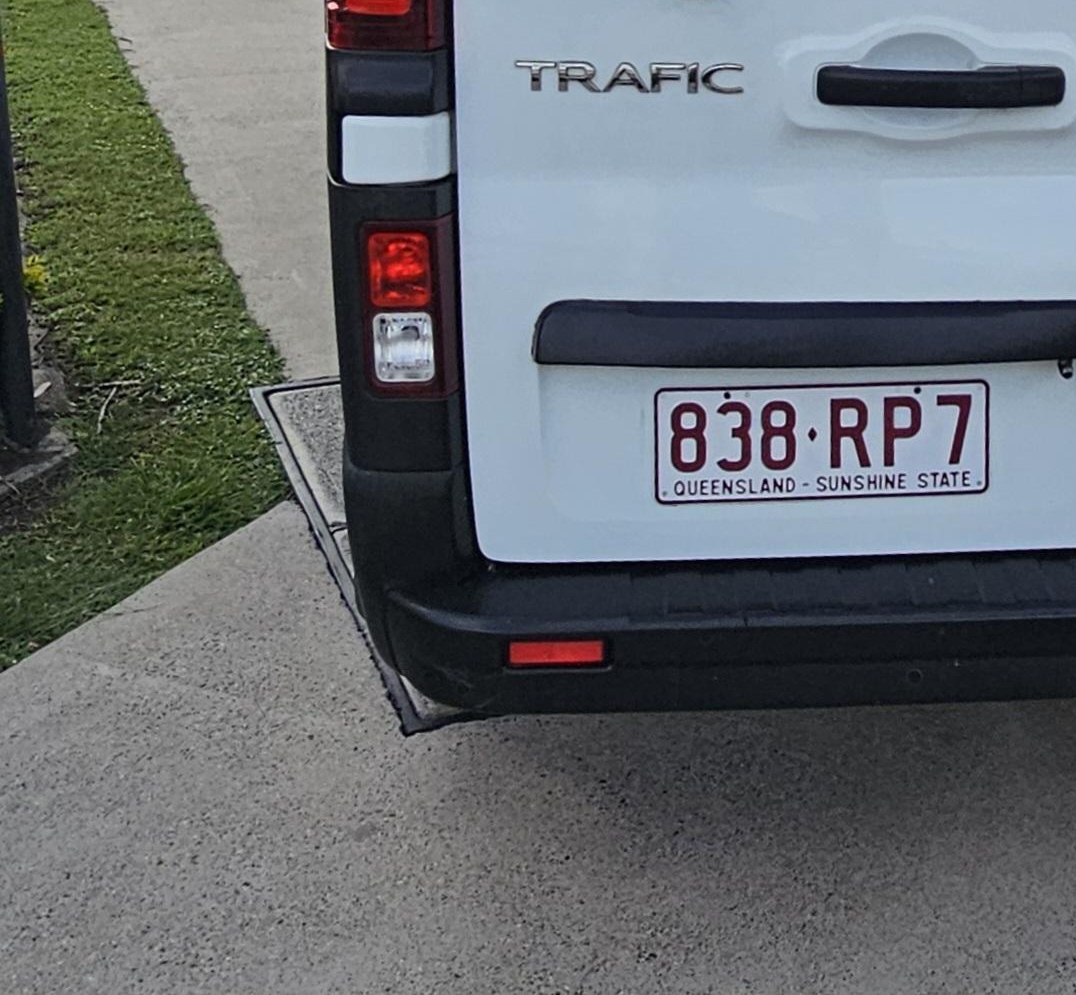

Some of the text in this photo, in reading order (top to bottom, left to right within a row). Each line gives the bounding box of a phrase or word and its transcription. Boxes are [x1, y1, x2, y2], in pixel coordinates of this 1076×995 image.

[514, 60, 744, 94] TRAFIC
[674, 477, 796, 496] QUEENSLAND
[816, 473, 907, 492] SUNSHINE
[918, 471, 971, 488] STATE
